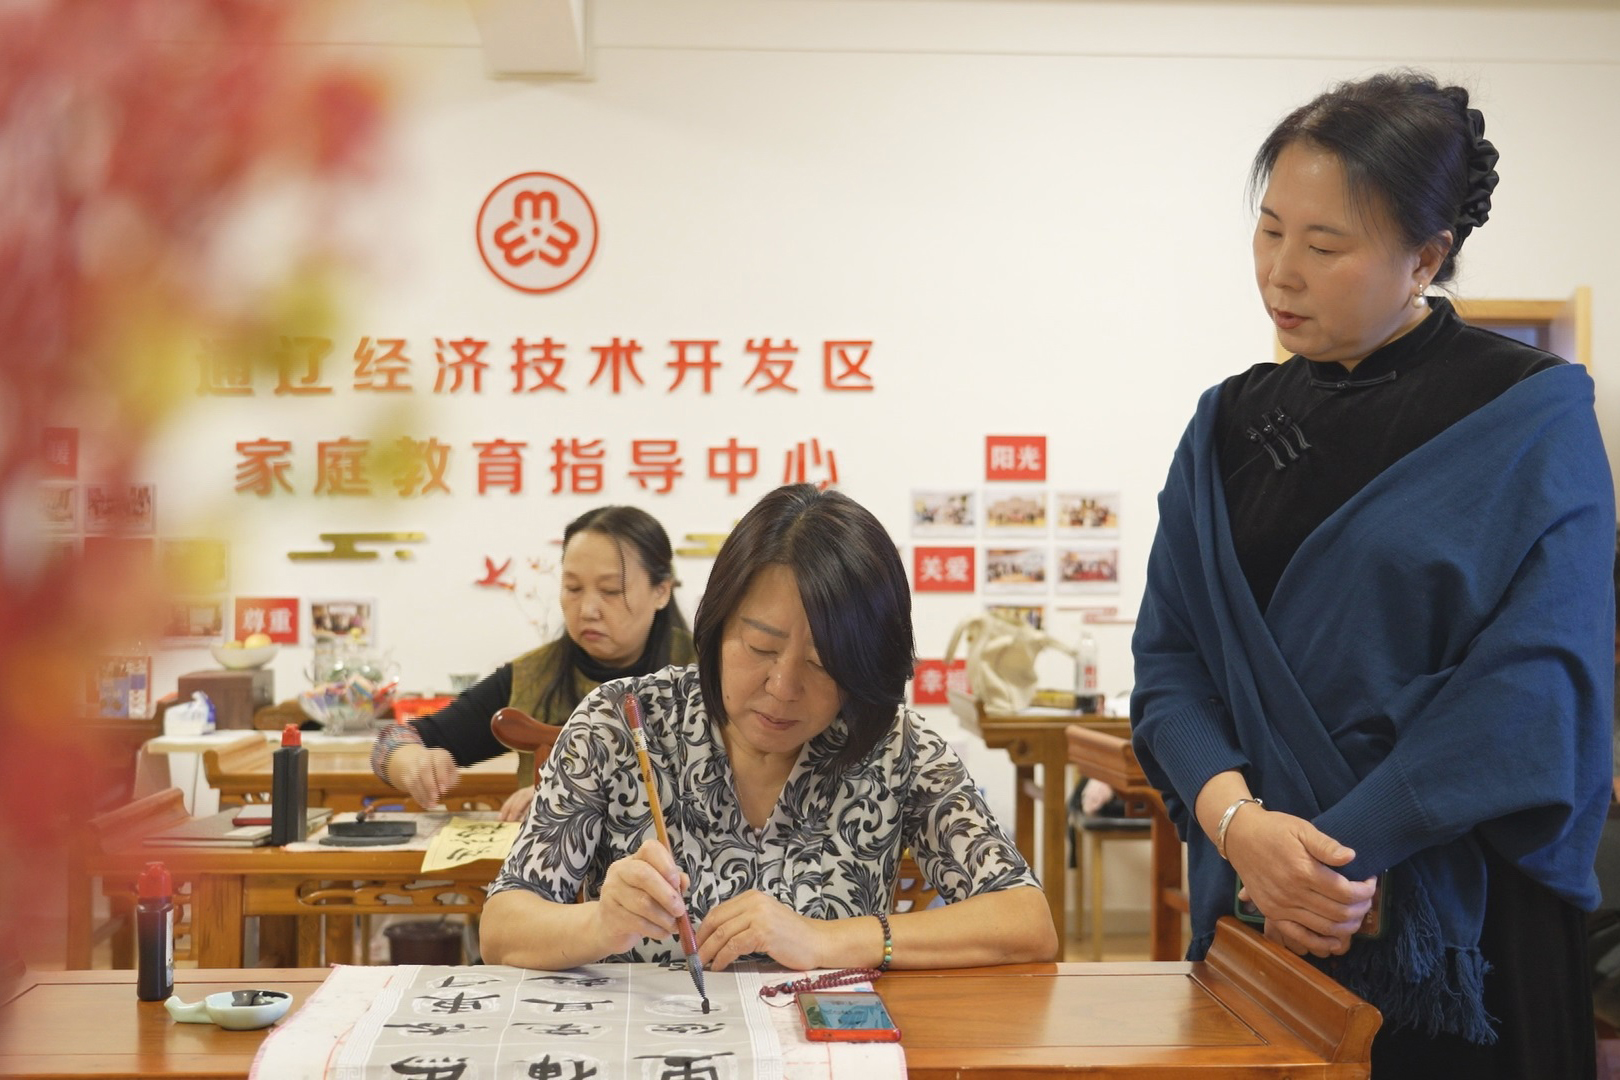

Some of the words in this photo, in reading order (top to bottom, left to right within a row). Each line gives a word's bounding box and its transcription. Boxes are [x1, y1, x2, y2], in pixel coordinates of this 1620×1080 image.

[196, 335, 875, 396] 通辽经济技术开发区
[234, 436, 838, 497] 家庭教育指导中心
[990, 444, 1042, 471] 阳光
[920, 554, 970, 583] 关爱
[242, 607, 292, 632] 尊重
